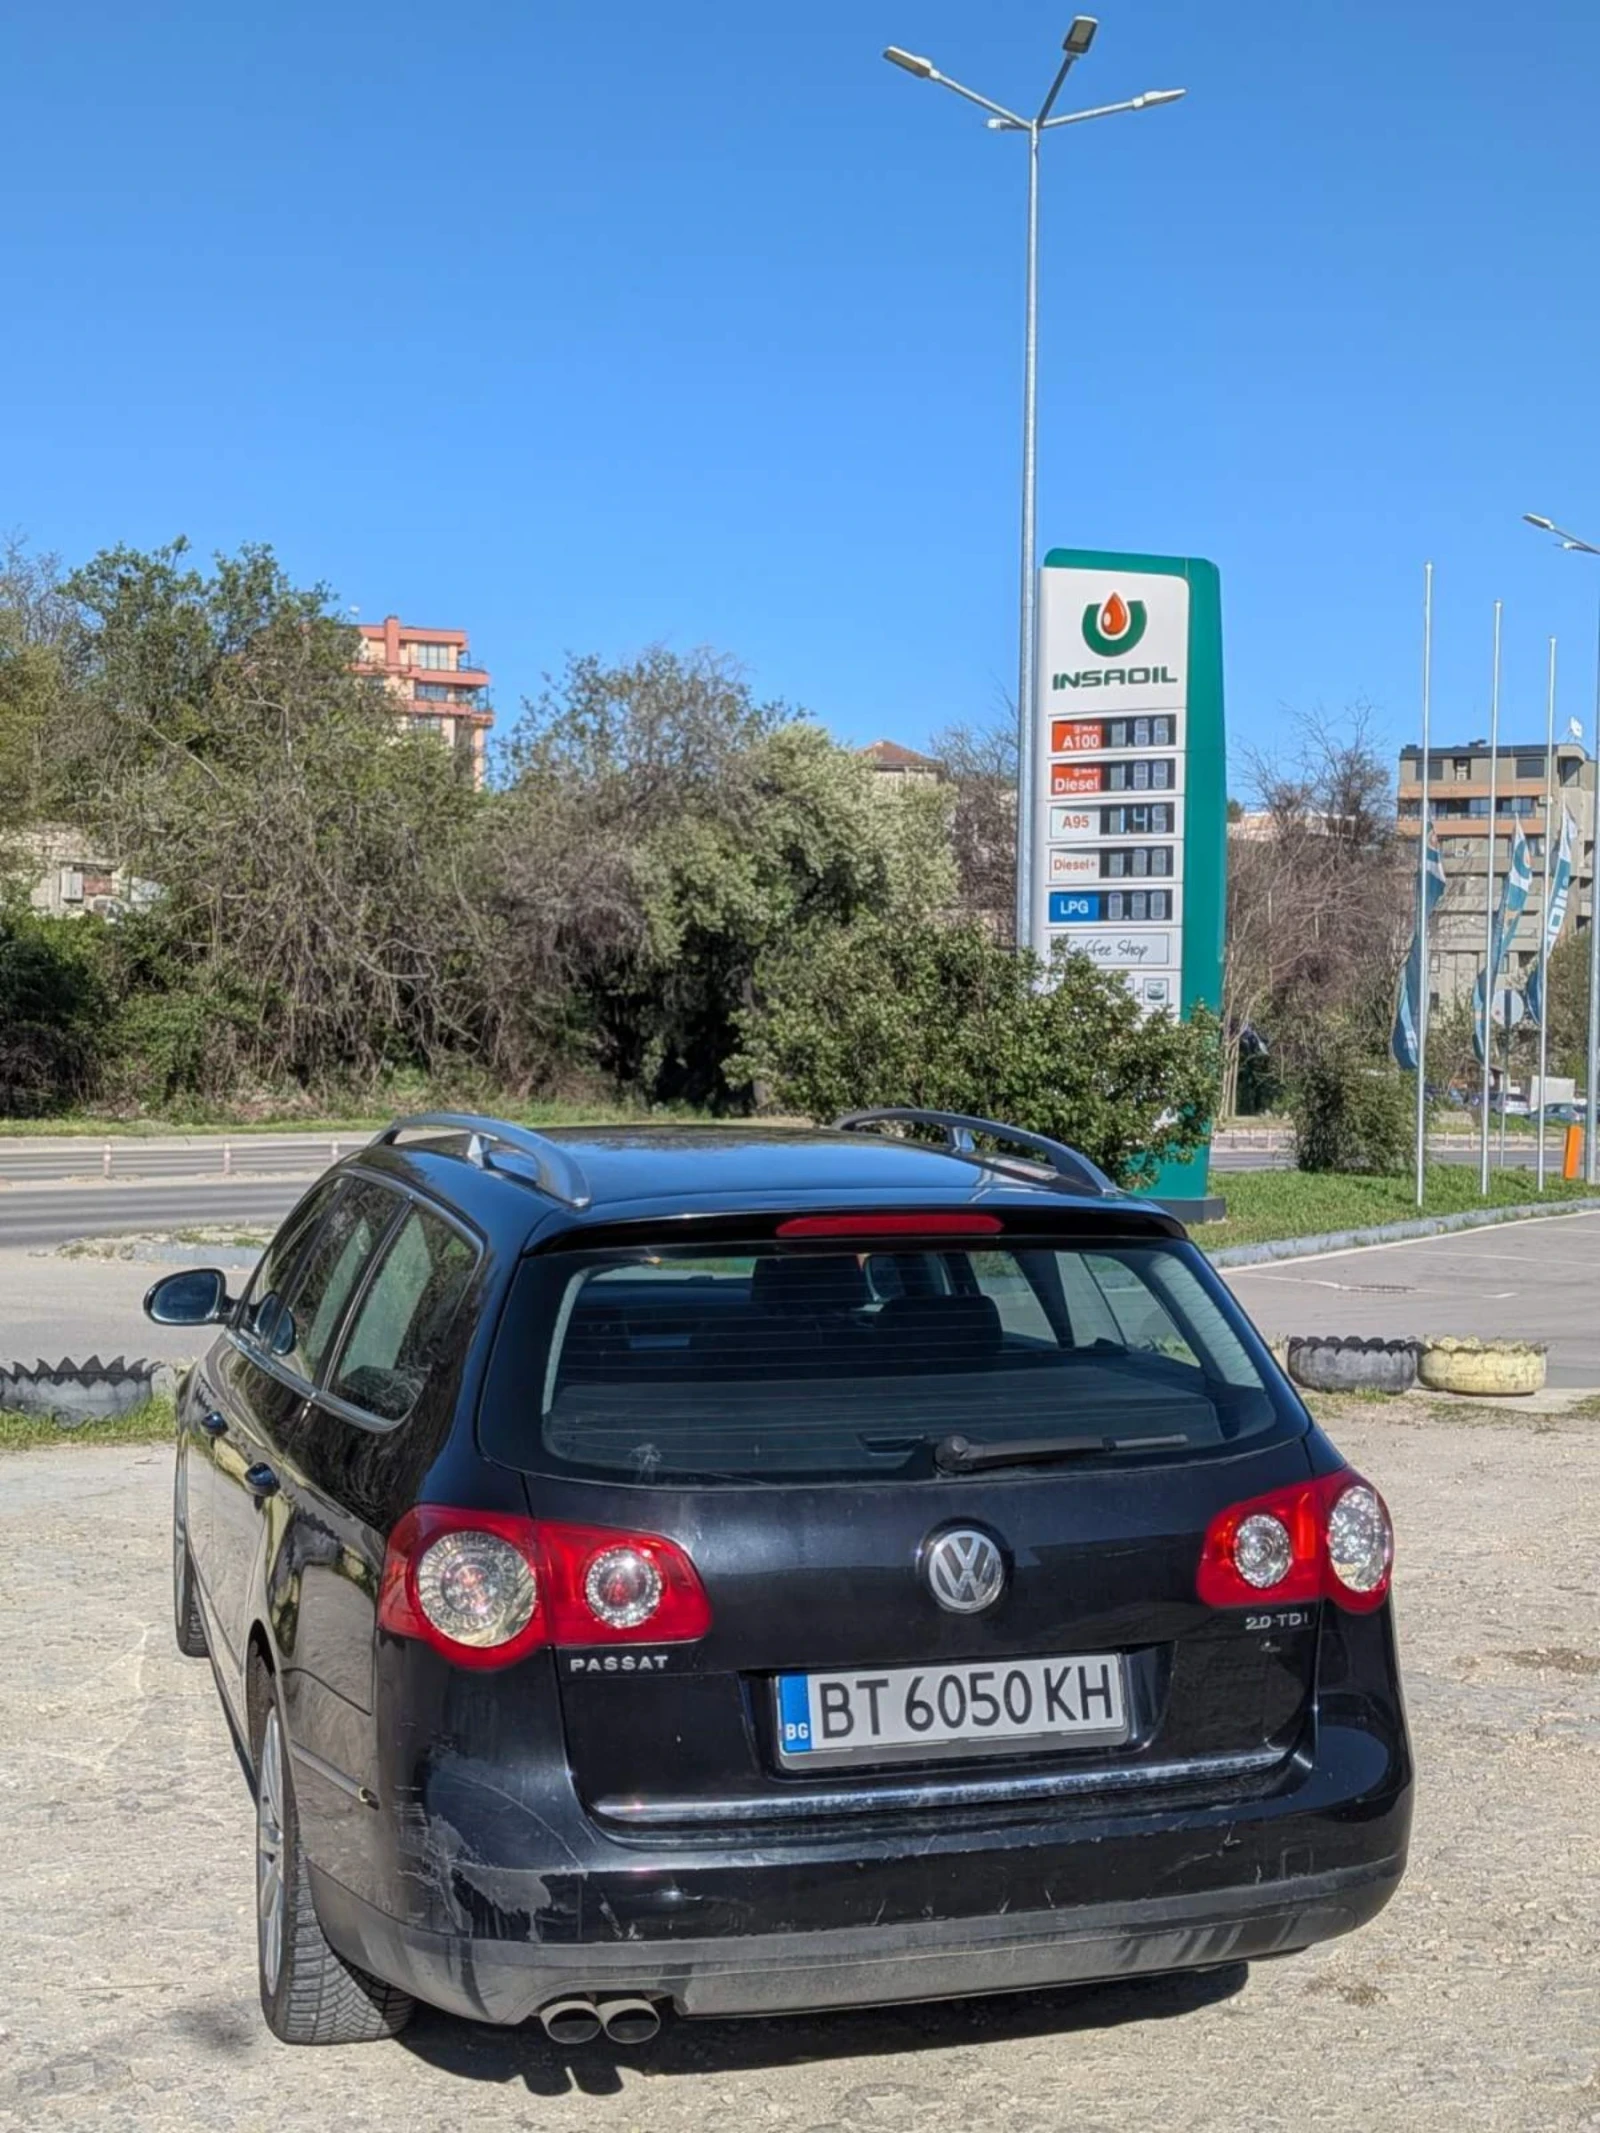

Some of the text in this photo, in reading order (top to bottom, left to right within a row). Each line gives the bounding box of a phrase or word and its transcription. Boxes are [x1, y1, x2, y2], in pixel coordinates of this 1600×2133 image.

[1052, 666, 1178, 691] INSAOIL
[1062, 734, 1100, 749] A100
[1054, 776, 1100, 792] Diesel
[1062, 815, 1090, 830] A95
[1060, 899, 1090, 915] LPG
[1117, 939, 1149, 962] Shop
[1276, 1611, 1308, 1627] TDI
[570, 1655, 669, 1672] PASSAT
[819, 1664, 1113, 1740] BT 6050 KH
[785, 1722, 809, 1741] BG
